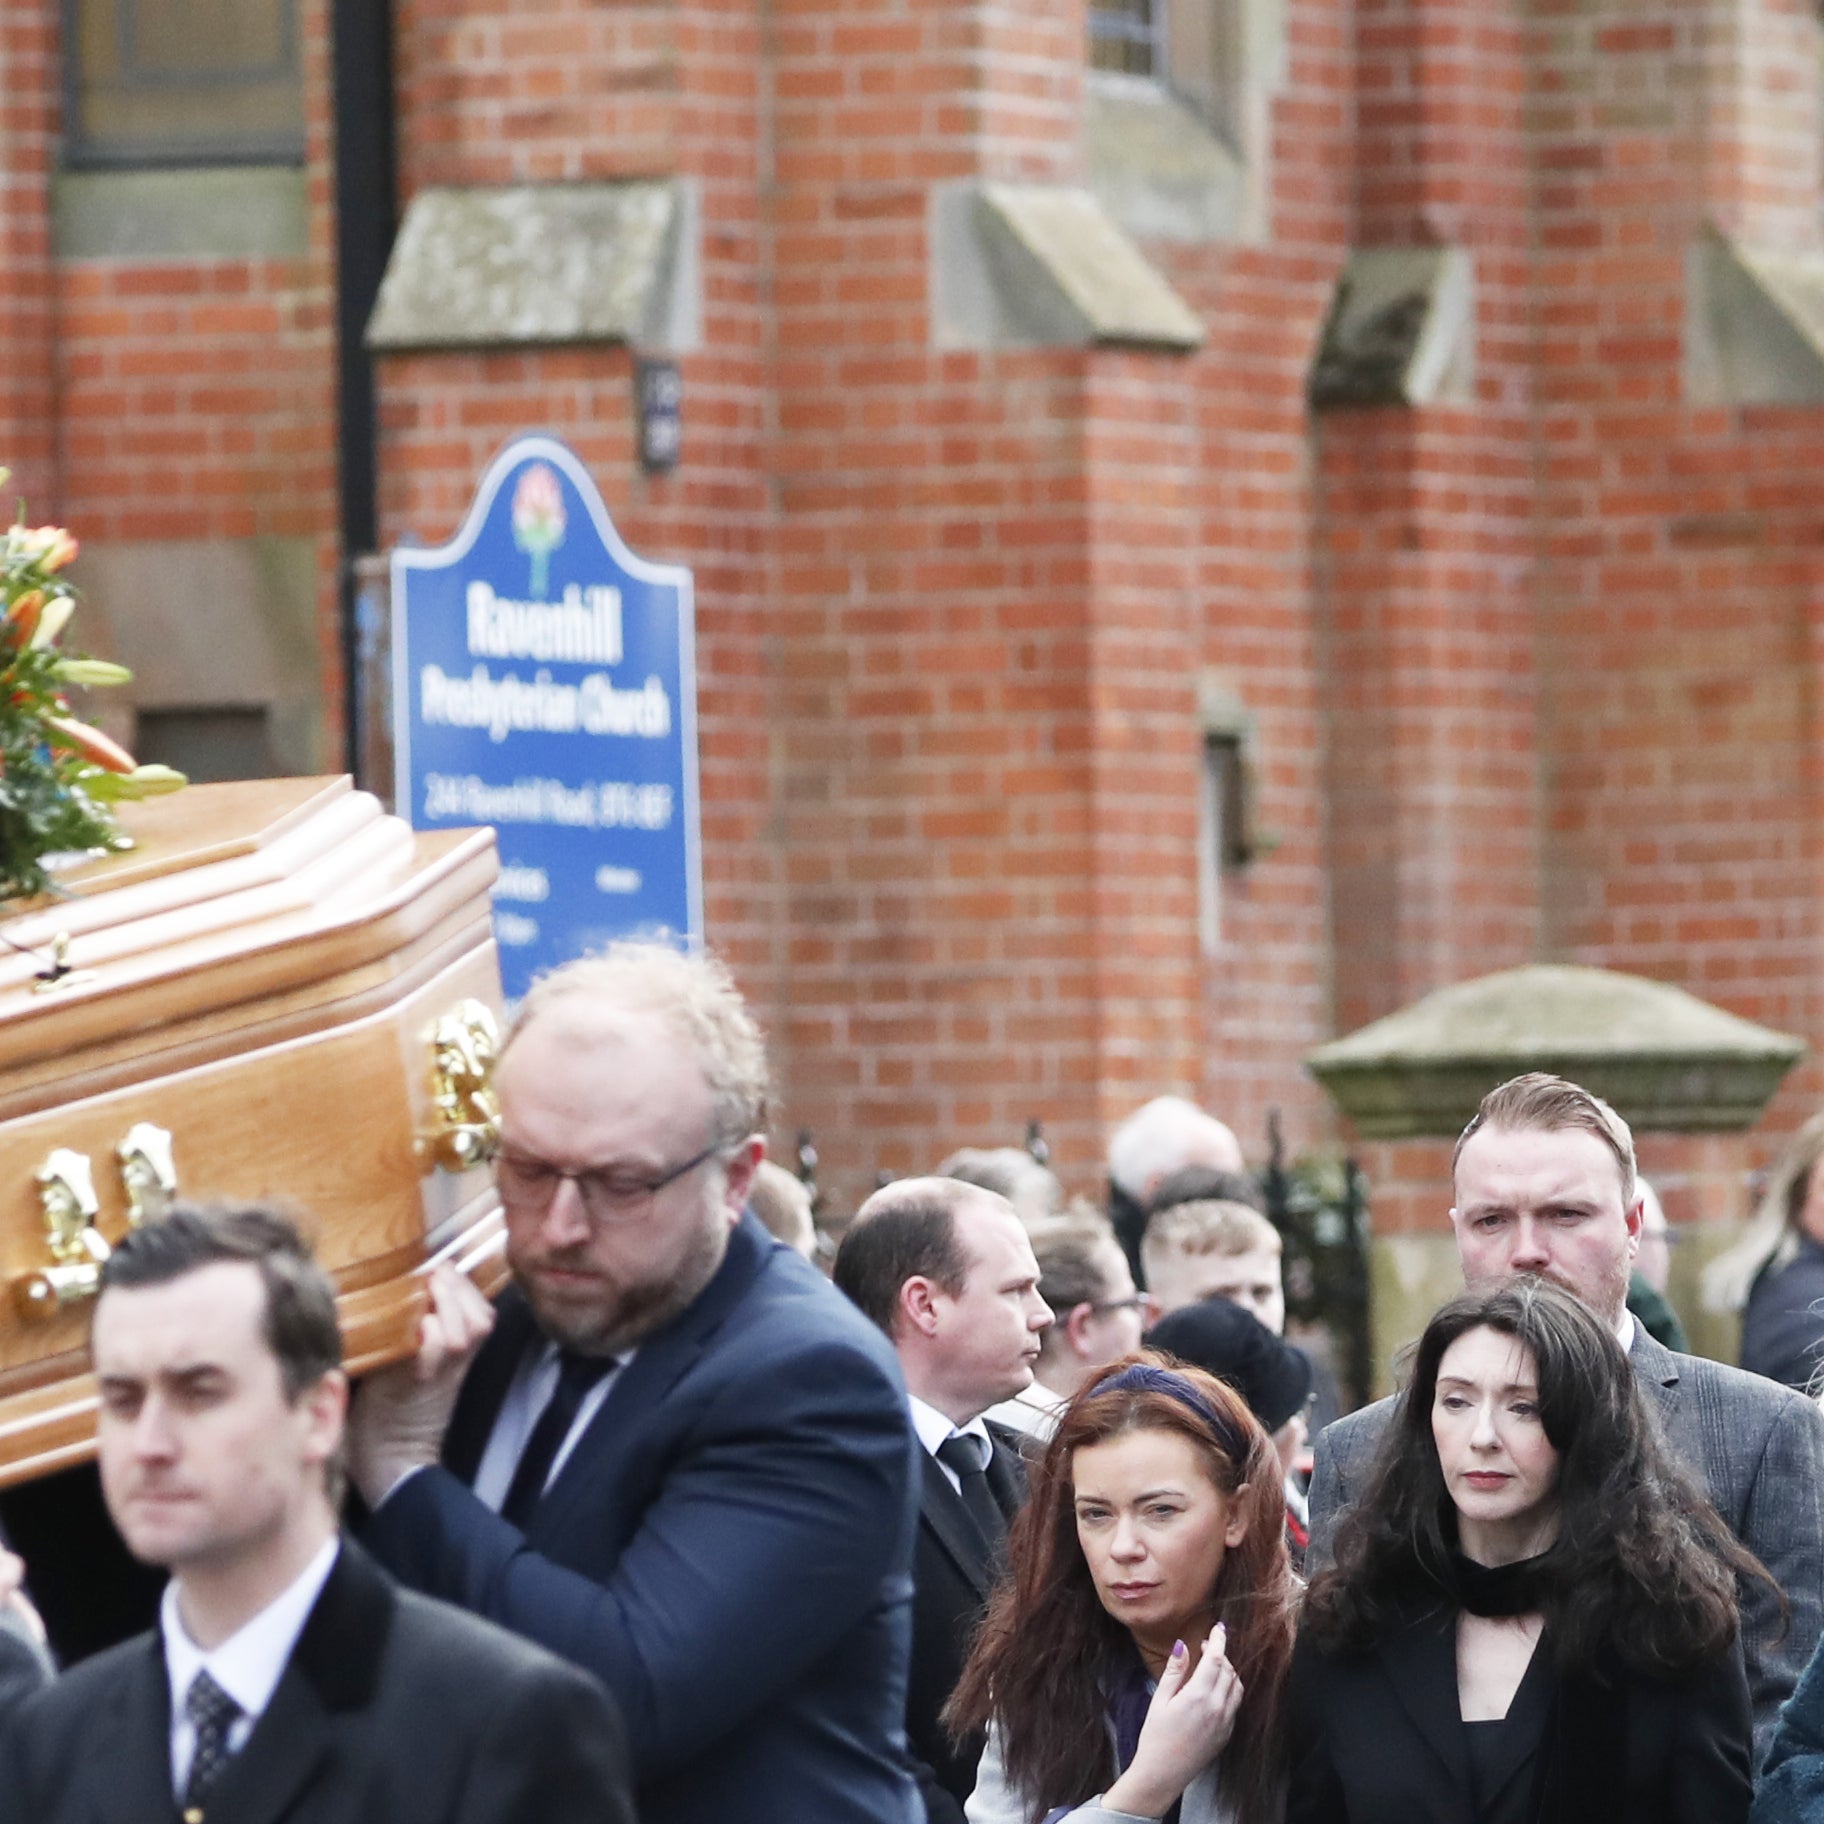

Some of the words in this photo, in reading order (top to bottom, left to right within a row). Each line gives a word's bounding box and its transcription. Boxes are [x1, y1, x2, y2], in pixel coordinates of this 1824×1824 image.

[467, 580, 623, 666] Ravenhill
[421, 664, 578, 743] Presbyterian
[579, 672, 671, 738] Church
